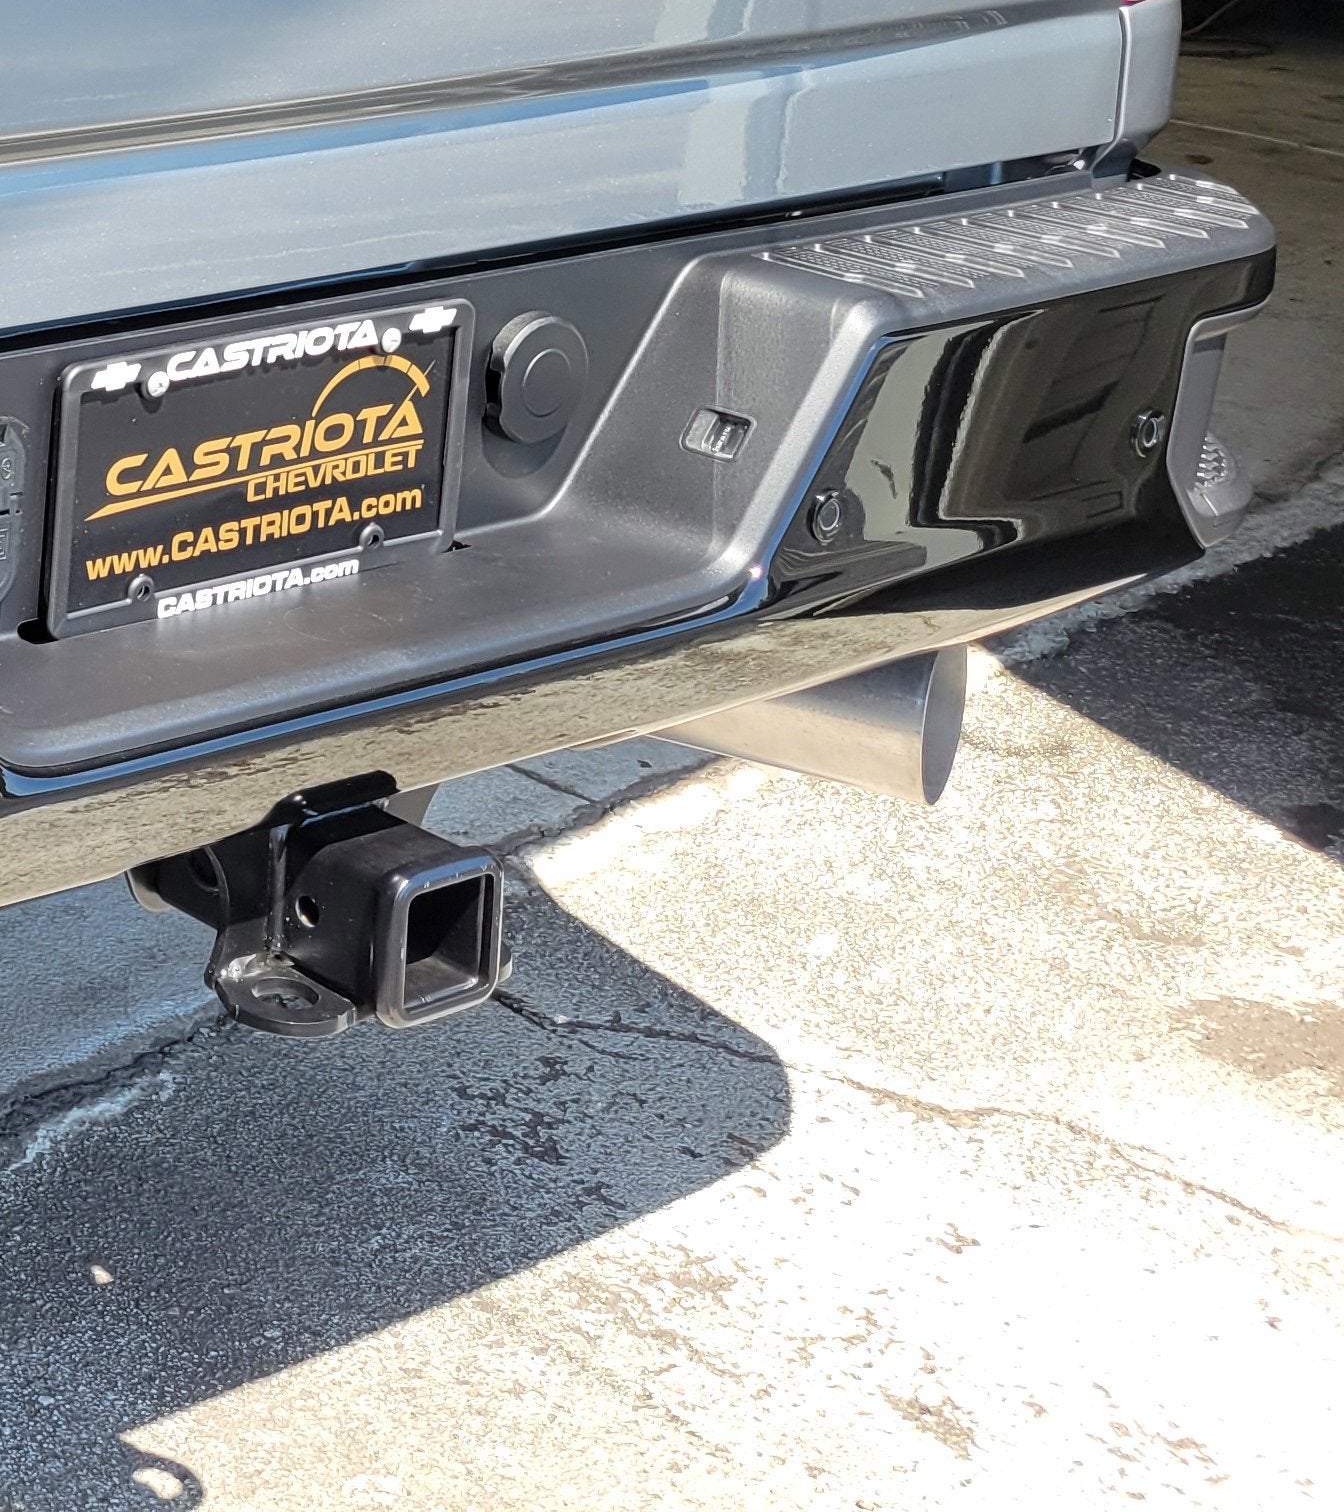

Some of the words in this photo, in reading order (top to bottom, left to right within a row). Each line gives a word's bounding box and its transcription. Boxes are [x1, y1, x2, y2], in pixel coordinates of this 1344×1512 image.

[165, 320, 379, 382] CASTRIOTA
[106, 401, 423, 497] CASTRIOTA
[246, 445, 422, 502] CHEVROLET
[86, 489, 422, 580] www.CASTRIOTA.com
[157, 558, 360, 619] CASTRIOTA.com
